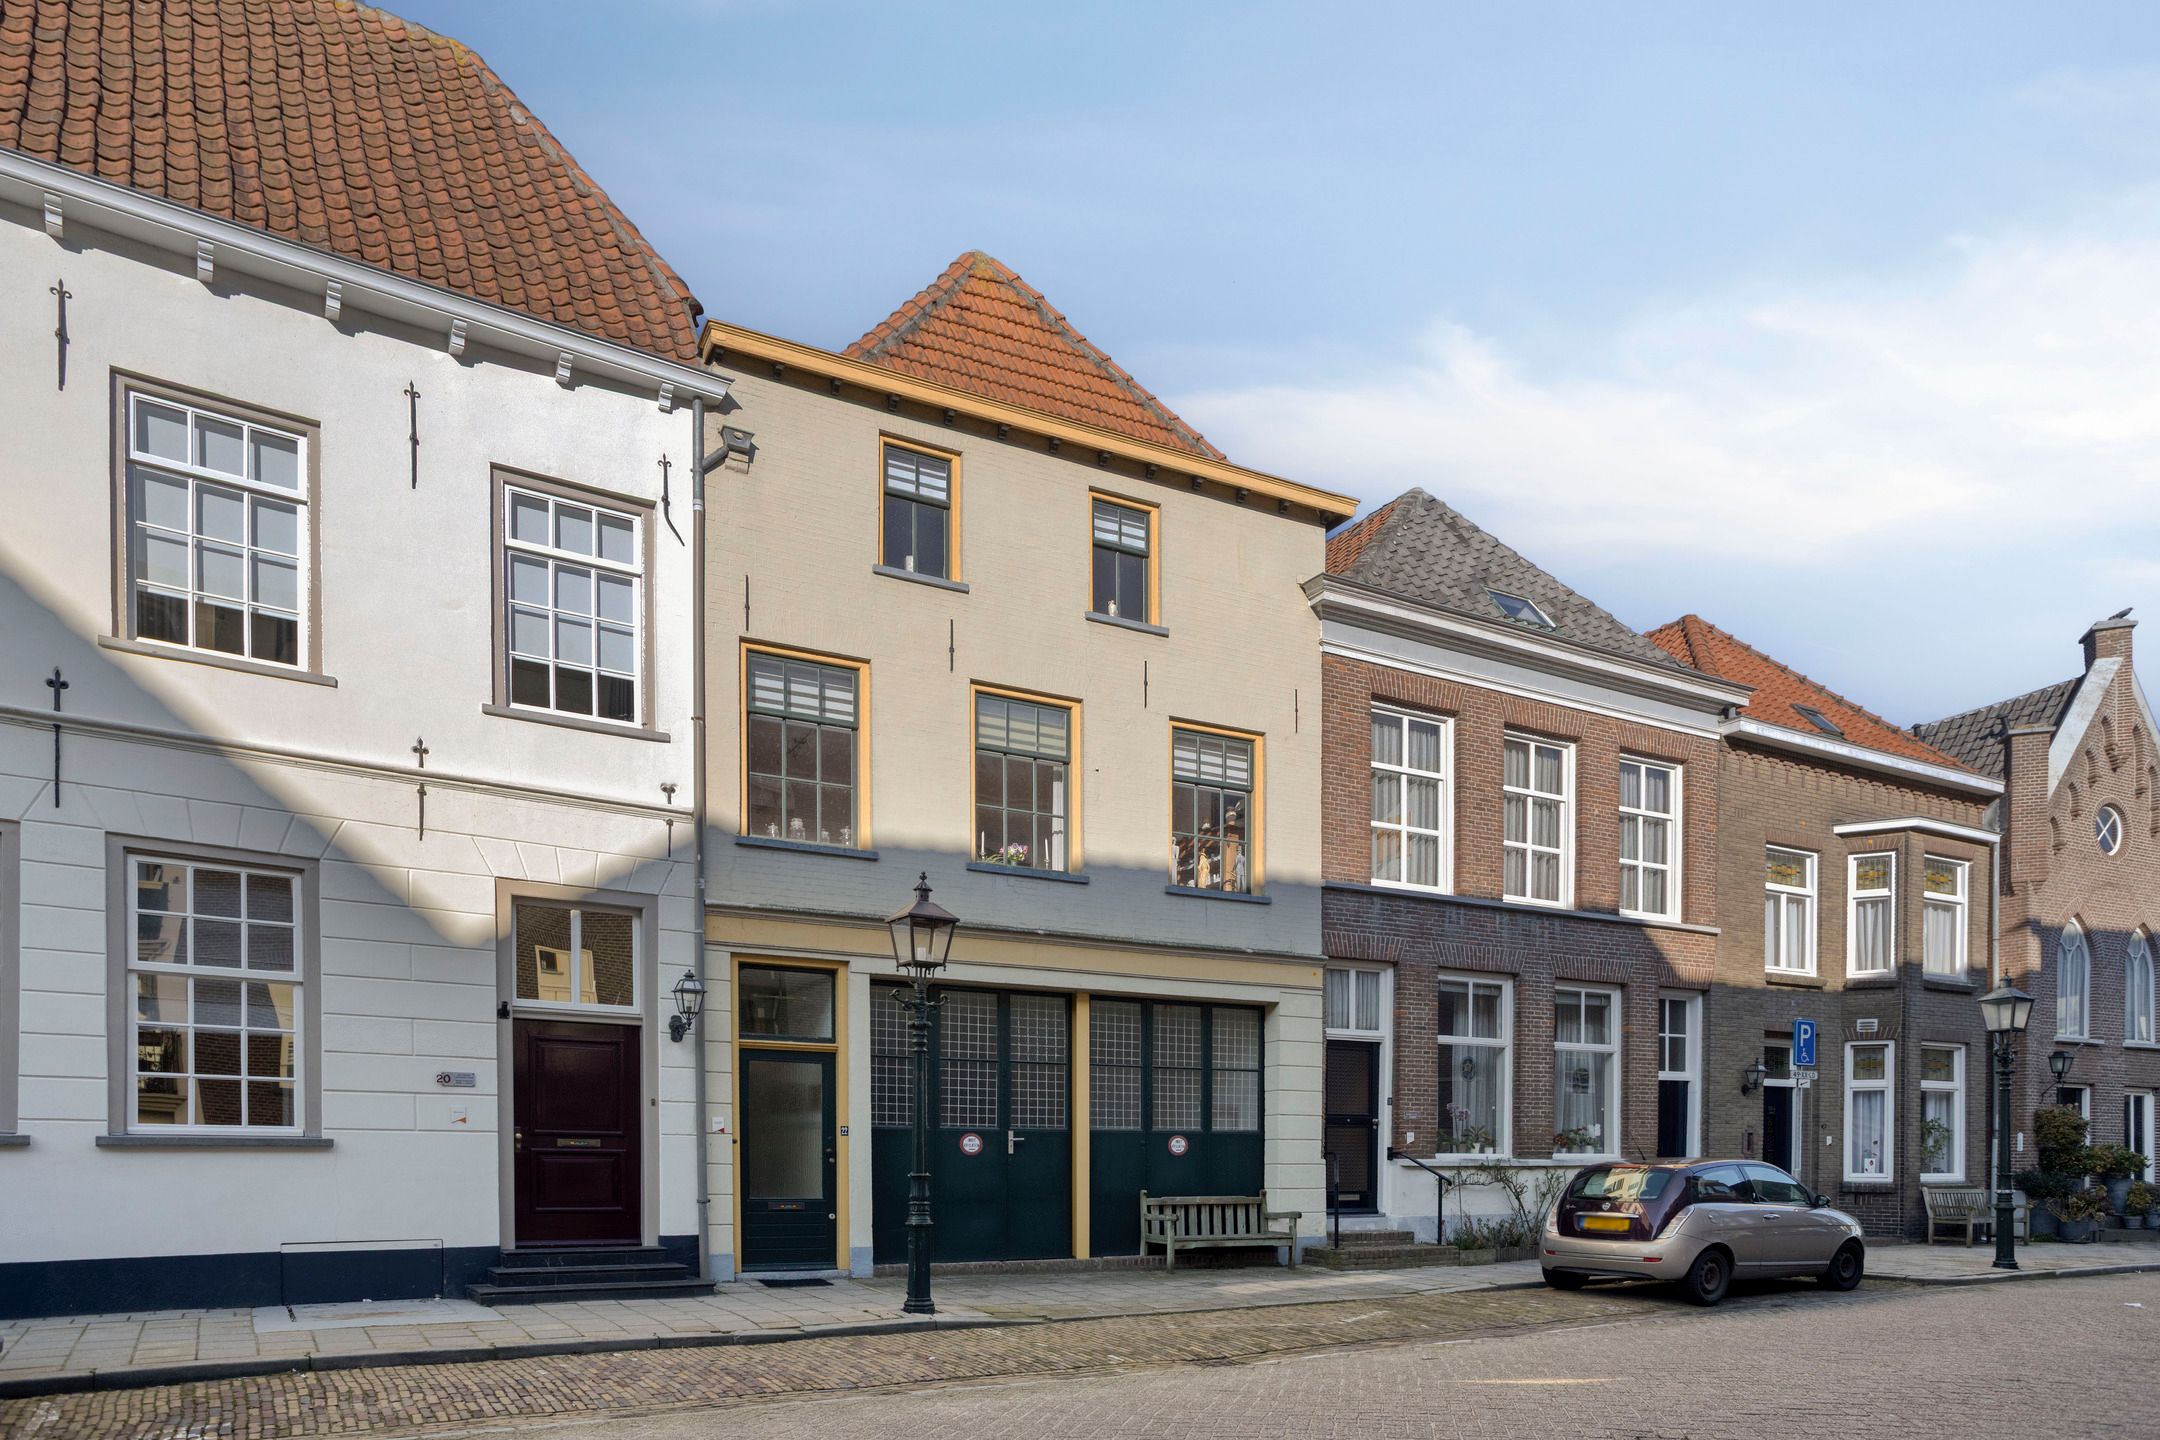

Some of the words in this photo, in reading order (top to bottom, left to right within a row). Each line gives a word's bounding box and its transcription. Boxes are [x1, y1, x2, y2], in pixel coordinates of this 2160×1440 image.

[1800, 1024, 1811, 1047] P
[436, 1074, 451, 1083] 20
[841, 1126, 848, 1135] 22
